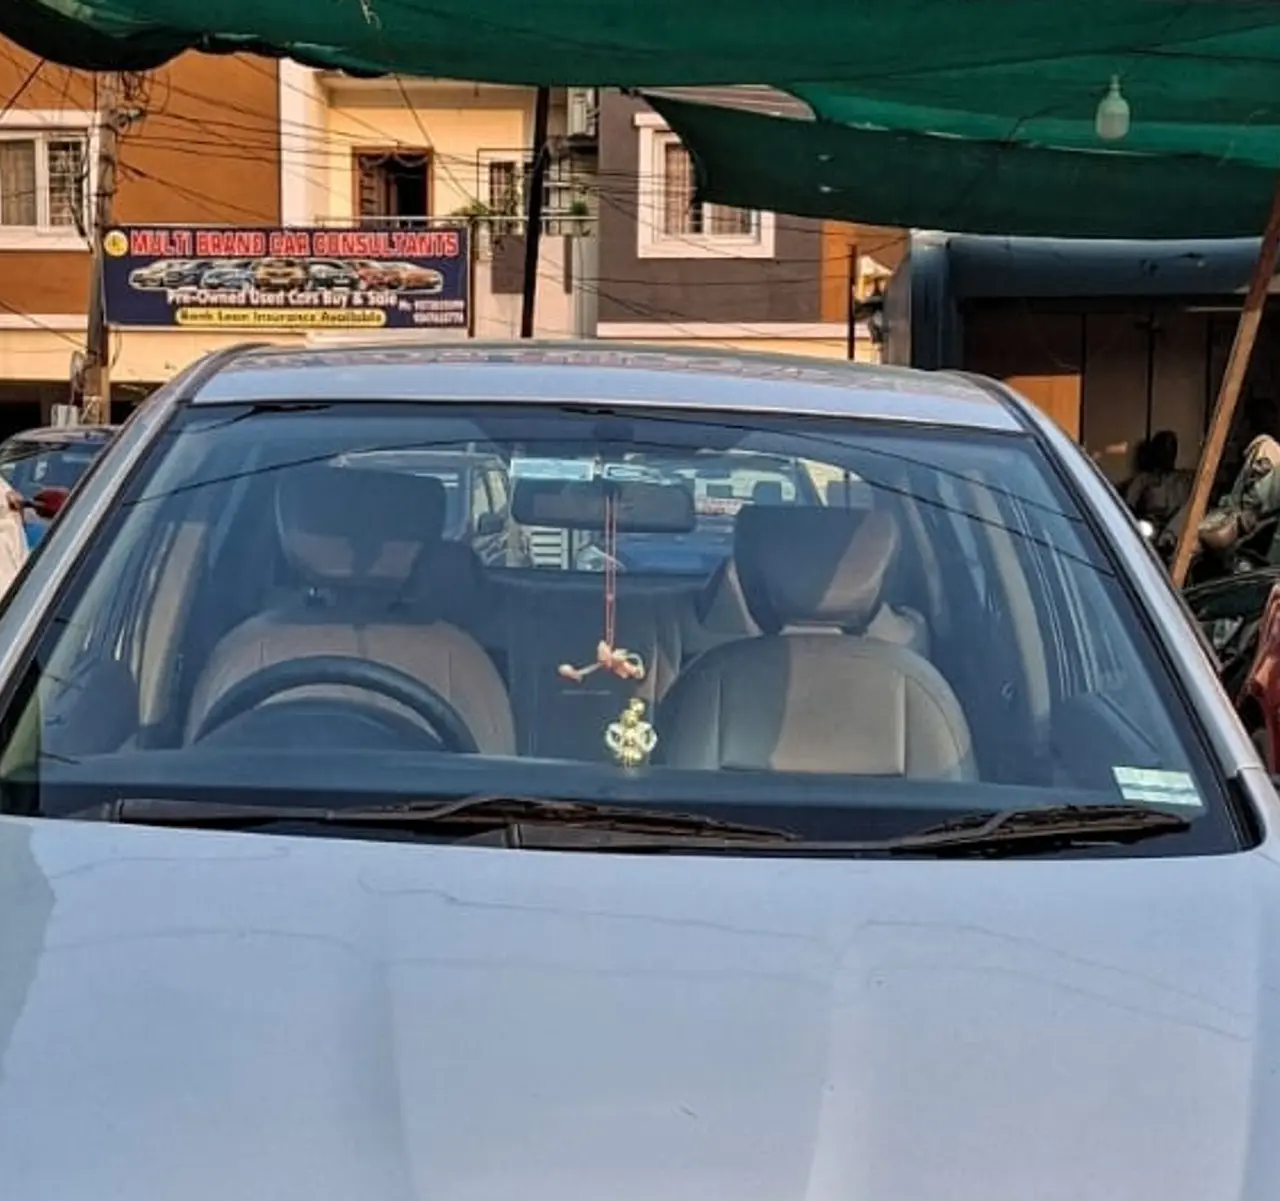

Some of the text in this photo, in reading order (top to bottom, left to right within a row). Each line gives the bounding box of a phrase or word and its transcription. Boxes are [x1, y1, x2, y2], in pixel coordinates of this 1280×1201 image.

[130, 230, 193, 256] MULTI
[195, 231, 267, 256] BRAND
[269, 231, 311, 256] CAR
[313, 231, 460, 257] CONSULTANTS
[249, 289, 285, 305] Used
[287, 289, 319, 305] Cars
[322, 289, 351, 309] Buy
[352, 290, 365, 305] &
